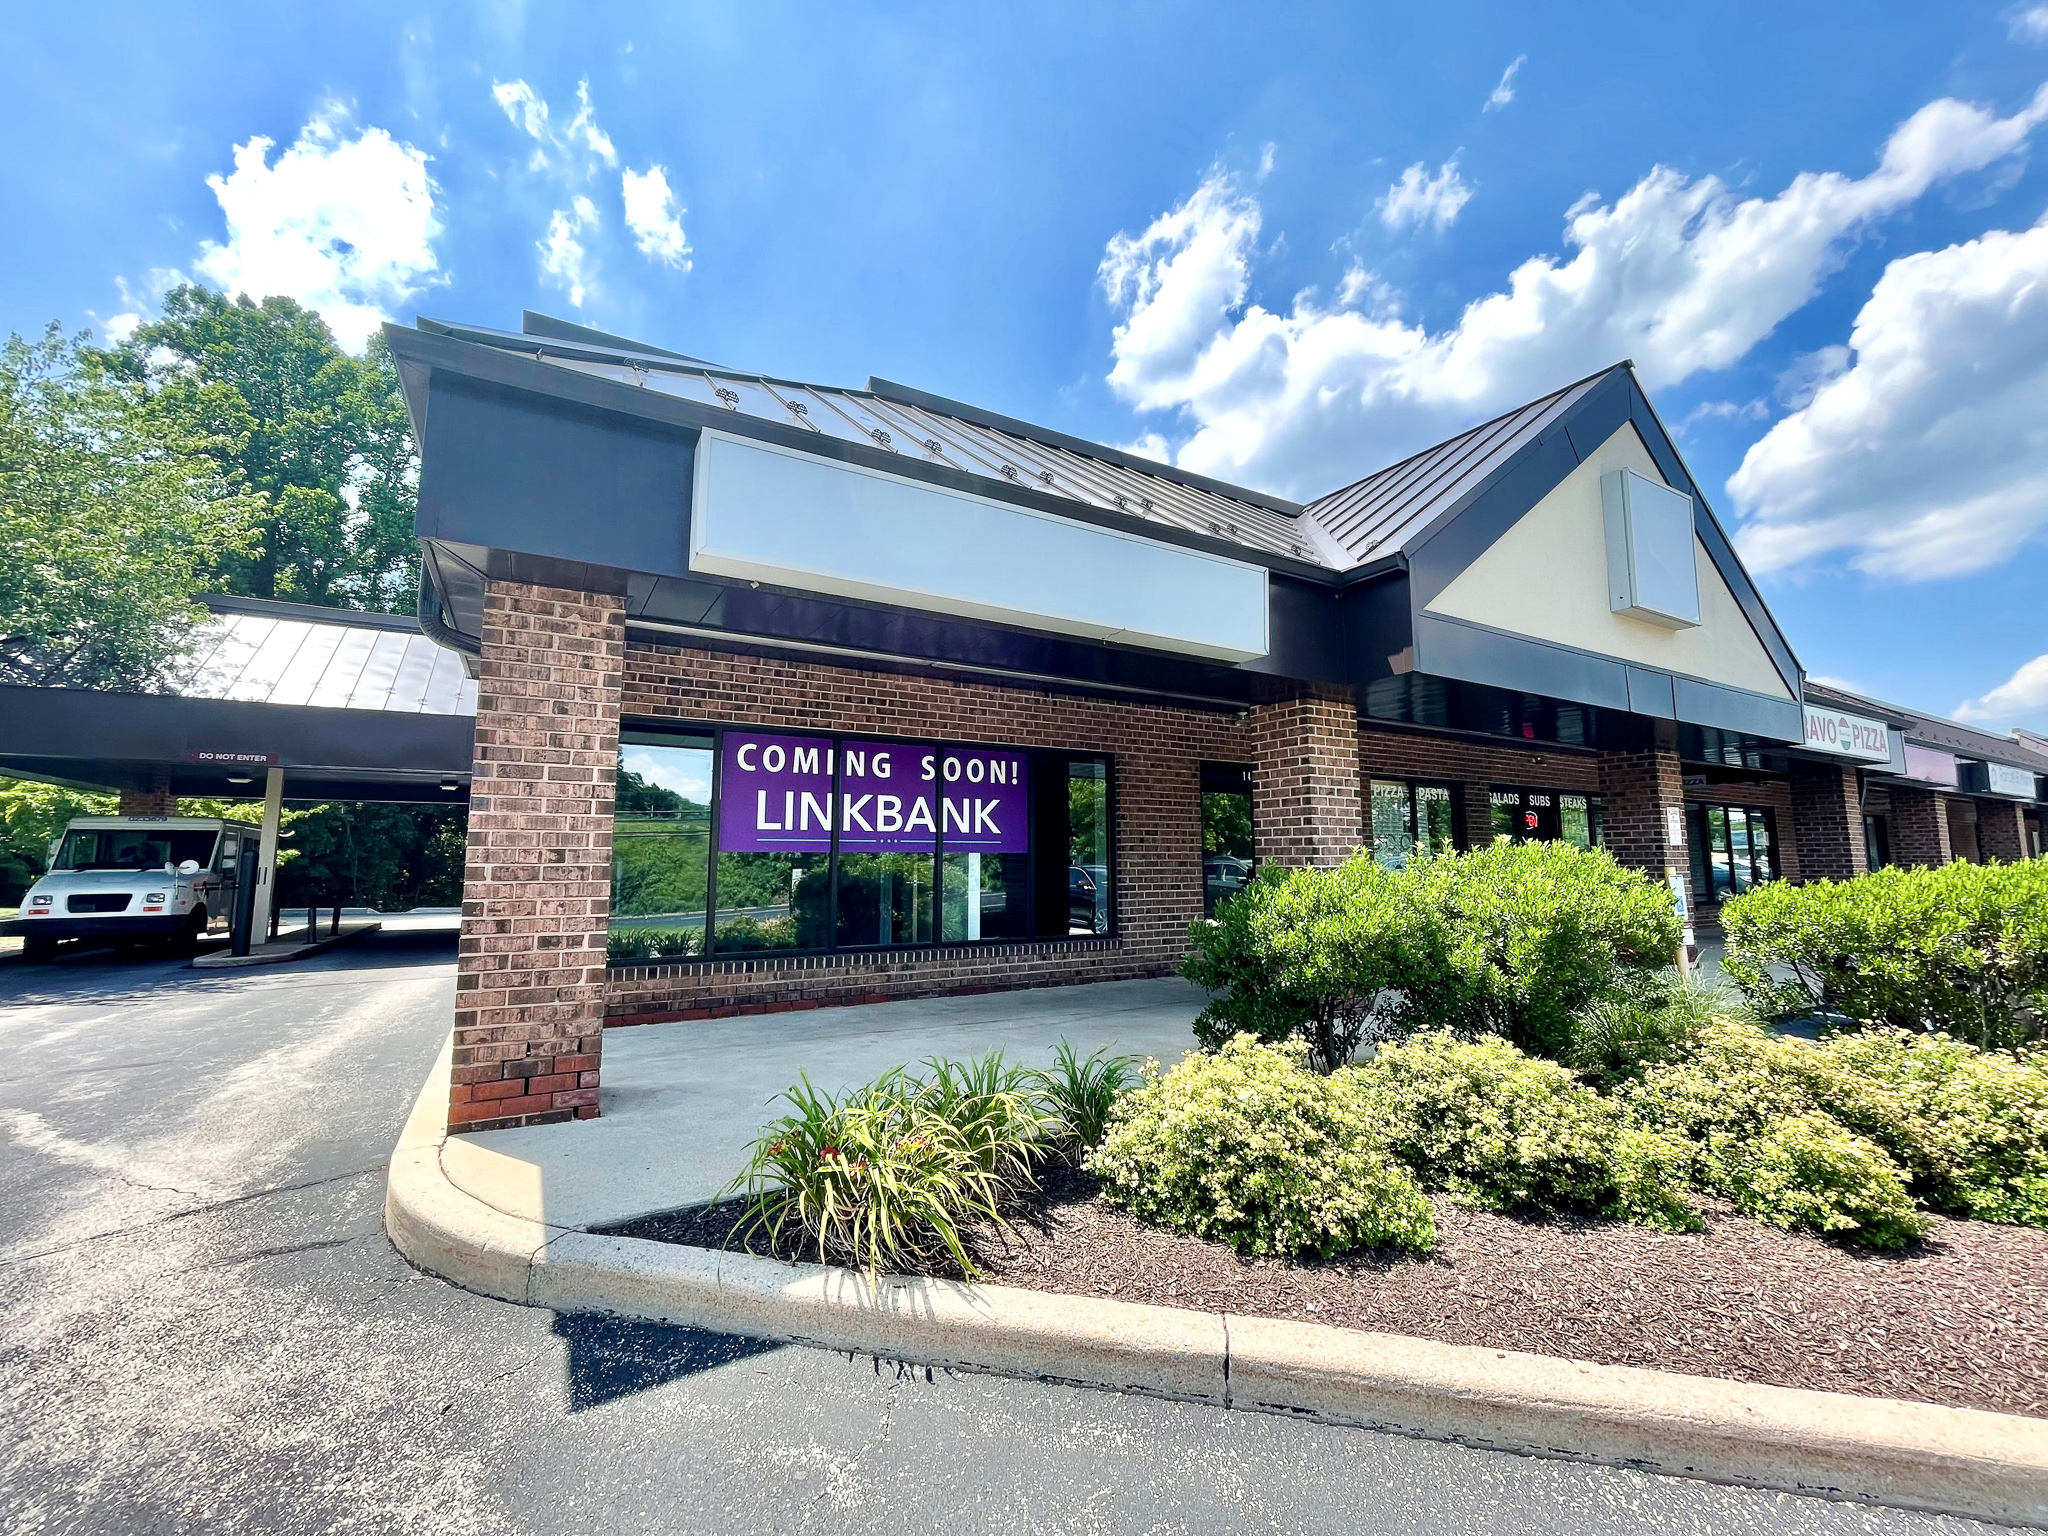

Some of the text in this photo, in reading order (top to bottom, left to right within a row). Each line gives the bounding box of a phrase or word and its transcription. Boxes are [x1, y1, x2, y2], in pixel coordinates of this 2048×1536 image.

[1804, 713, 1887, 753] AVO PIZZA
[199, 752, 267, 762] DO NOT ENTER
[736, 742, 1019, 786] COMING SOON!
[756, 789, 1002, 834] LINKBANK
[1373, 784, 1405, 799] PIZZA
[1417, 786, 1450, 802] PASTA
[1529, 794, 1551, 807] SUBS
[1559, 794, 1587, 810] STEAKS
